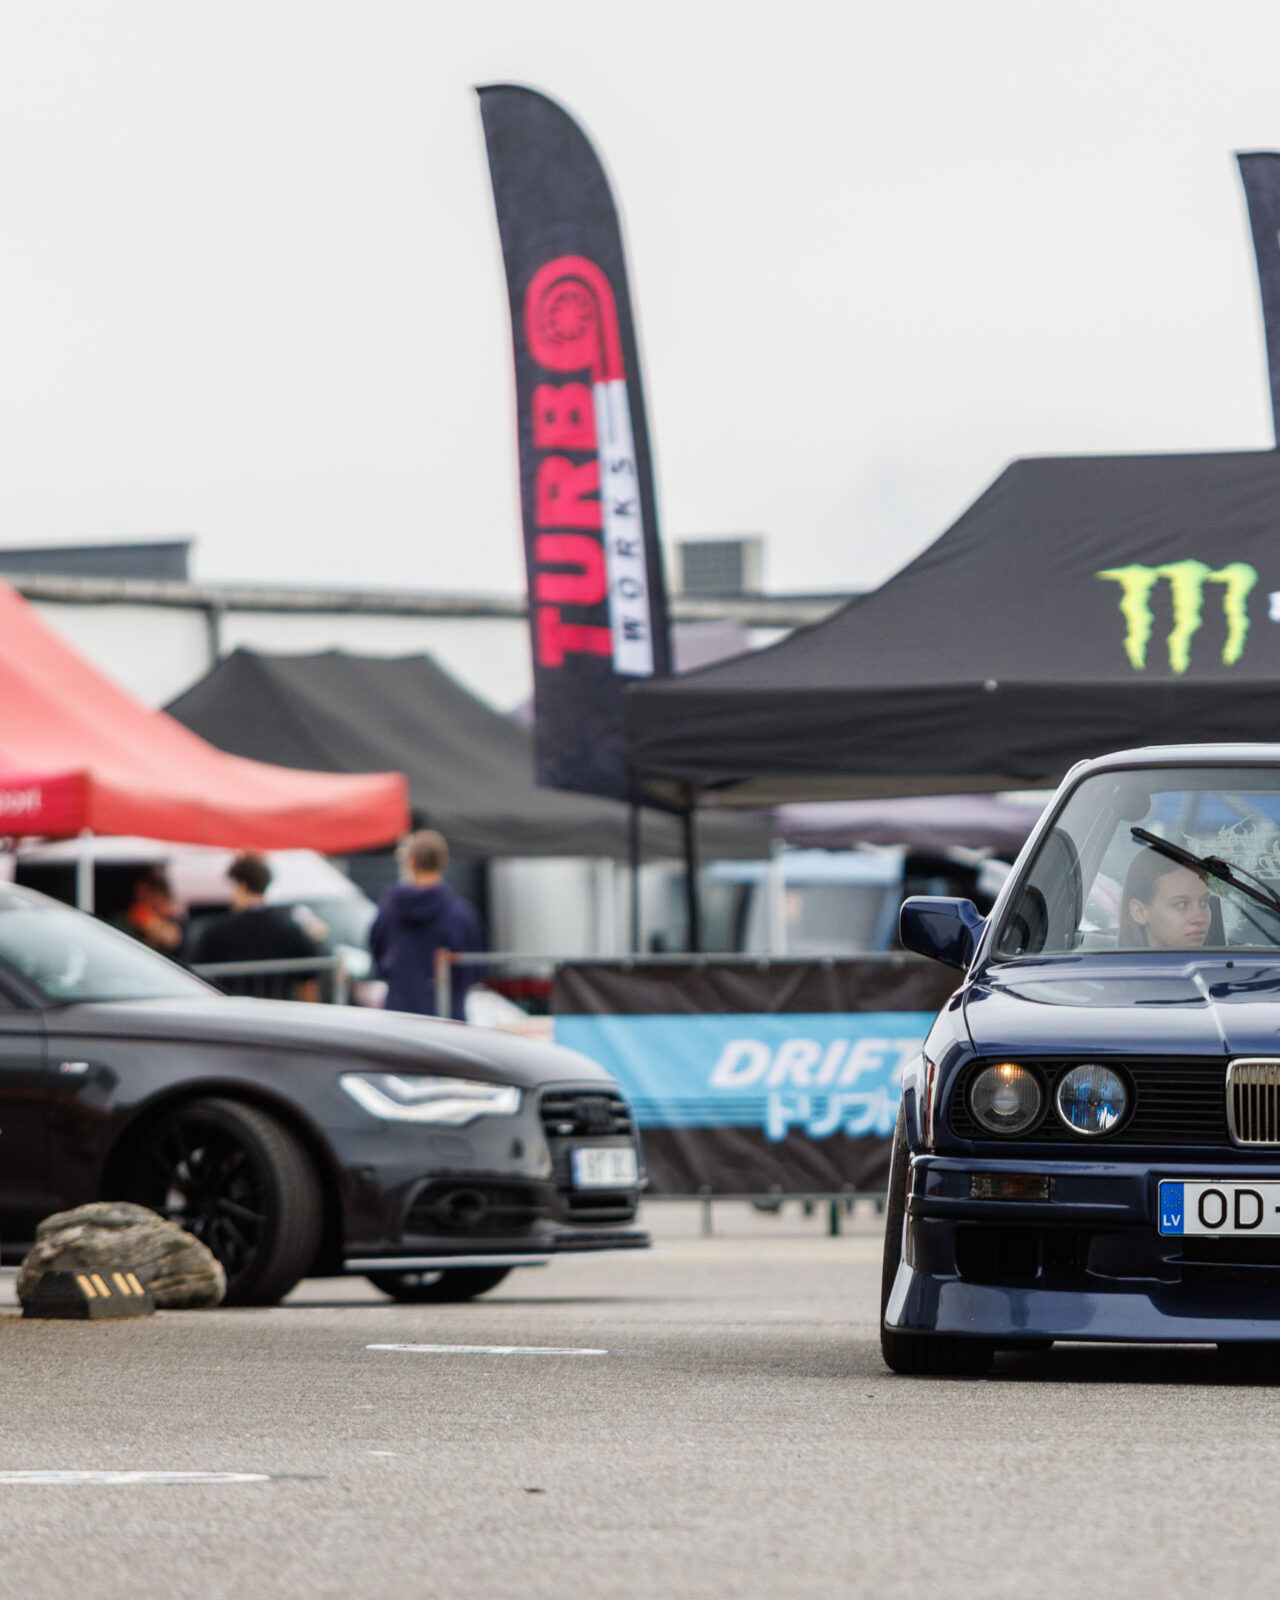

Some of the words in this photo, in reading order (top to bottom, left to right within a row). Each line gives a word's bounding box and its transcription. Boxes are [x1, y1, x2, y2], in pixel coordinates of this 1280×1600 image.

[524, 254, 626, 669] TURBO
[611, 457, 646, 642] WORKS
[709, 1037, 923, 1087] DRIFT
[1163, 1214, 1181, 1226] LV
